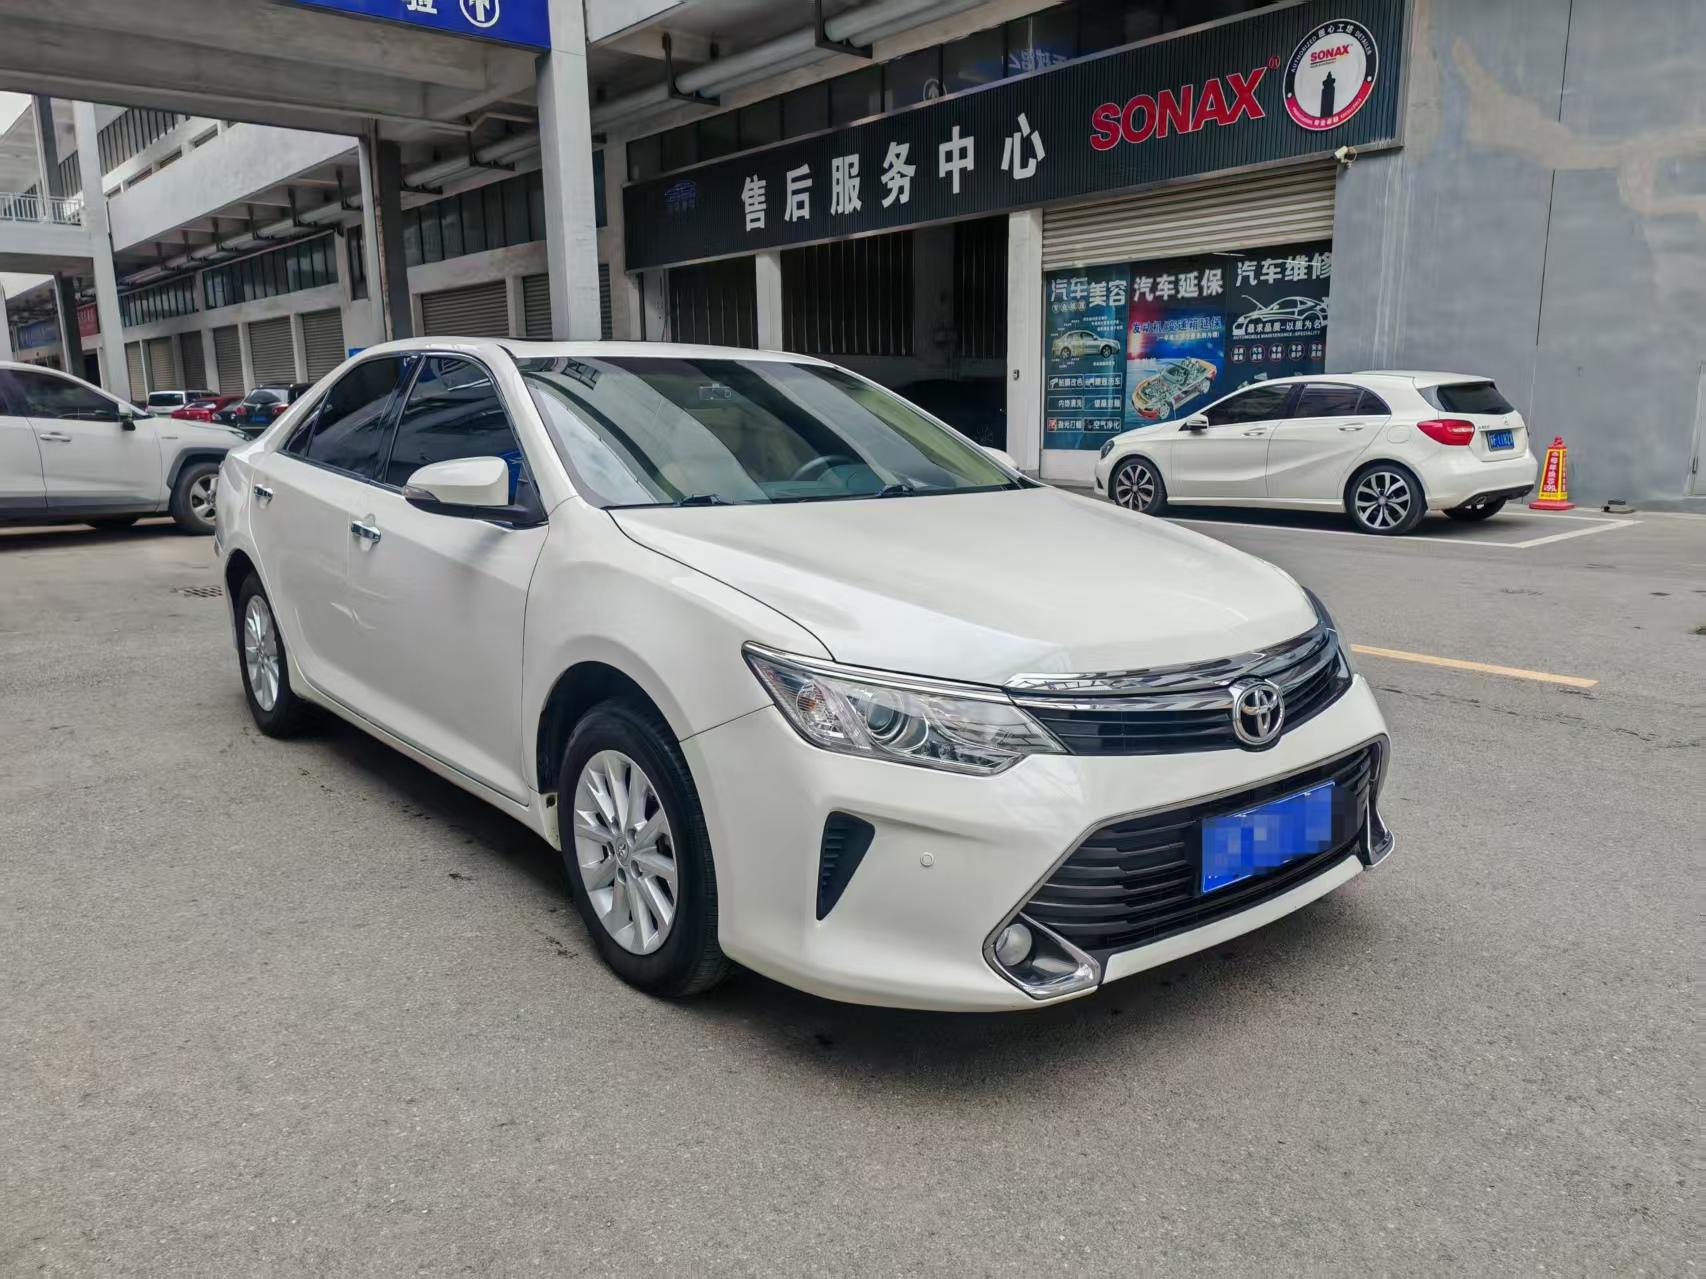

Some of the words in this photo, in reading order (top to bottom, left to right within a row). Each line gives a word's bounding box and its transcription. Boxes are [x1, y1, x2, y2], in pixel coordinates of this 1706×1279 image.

[1291, 36, 1317, 73] AUTHORIZED
[1310, 44, 1350, 62] SONAX
[1090, 66, 1268, 150] SONAX
[741, 112, 1046, 232] 售后服务中心
[1134, 268, 1223, 302] 汽车延保
[1236, 252, 1332, 287] 汽车维修
[1051, 277, 1127, 307] 汽车美容
[1094, 420, 1120, 430] 空气净化
